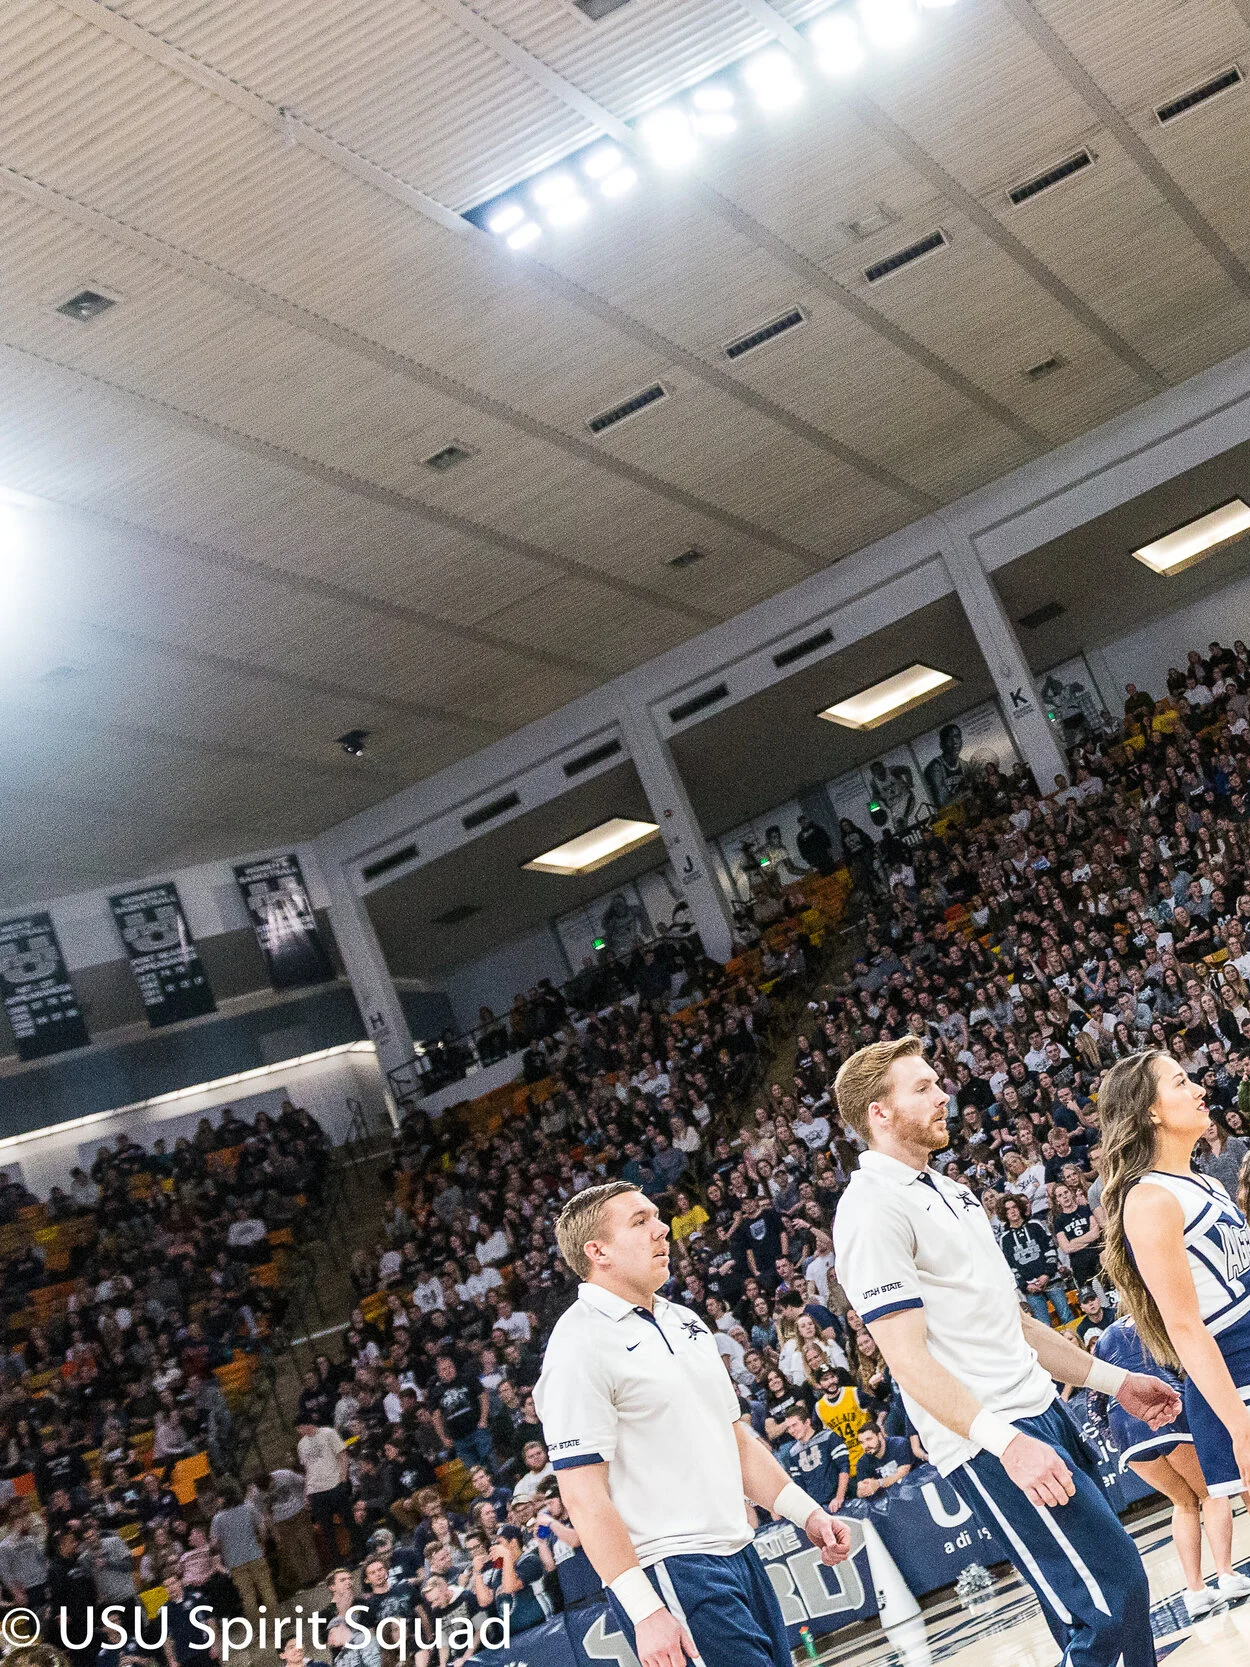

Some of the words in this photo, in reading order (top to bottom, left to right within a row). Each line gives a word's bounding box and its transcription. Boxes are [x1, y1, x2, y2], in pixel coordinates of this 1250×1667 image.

[1010, 686, 1029, 708] K
[1064, 1216, 1089, 1233] UTAH
[1073, 1226, 1084, 1237] 6
[862, 1287, 881, 1300] UTAH
[880, 1281, 904, 1293] STATE
[836, 1422, 856, 1439] 14
[558, 1439, 581, 1450] STATE
